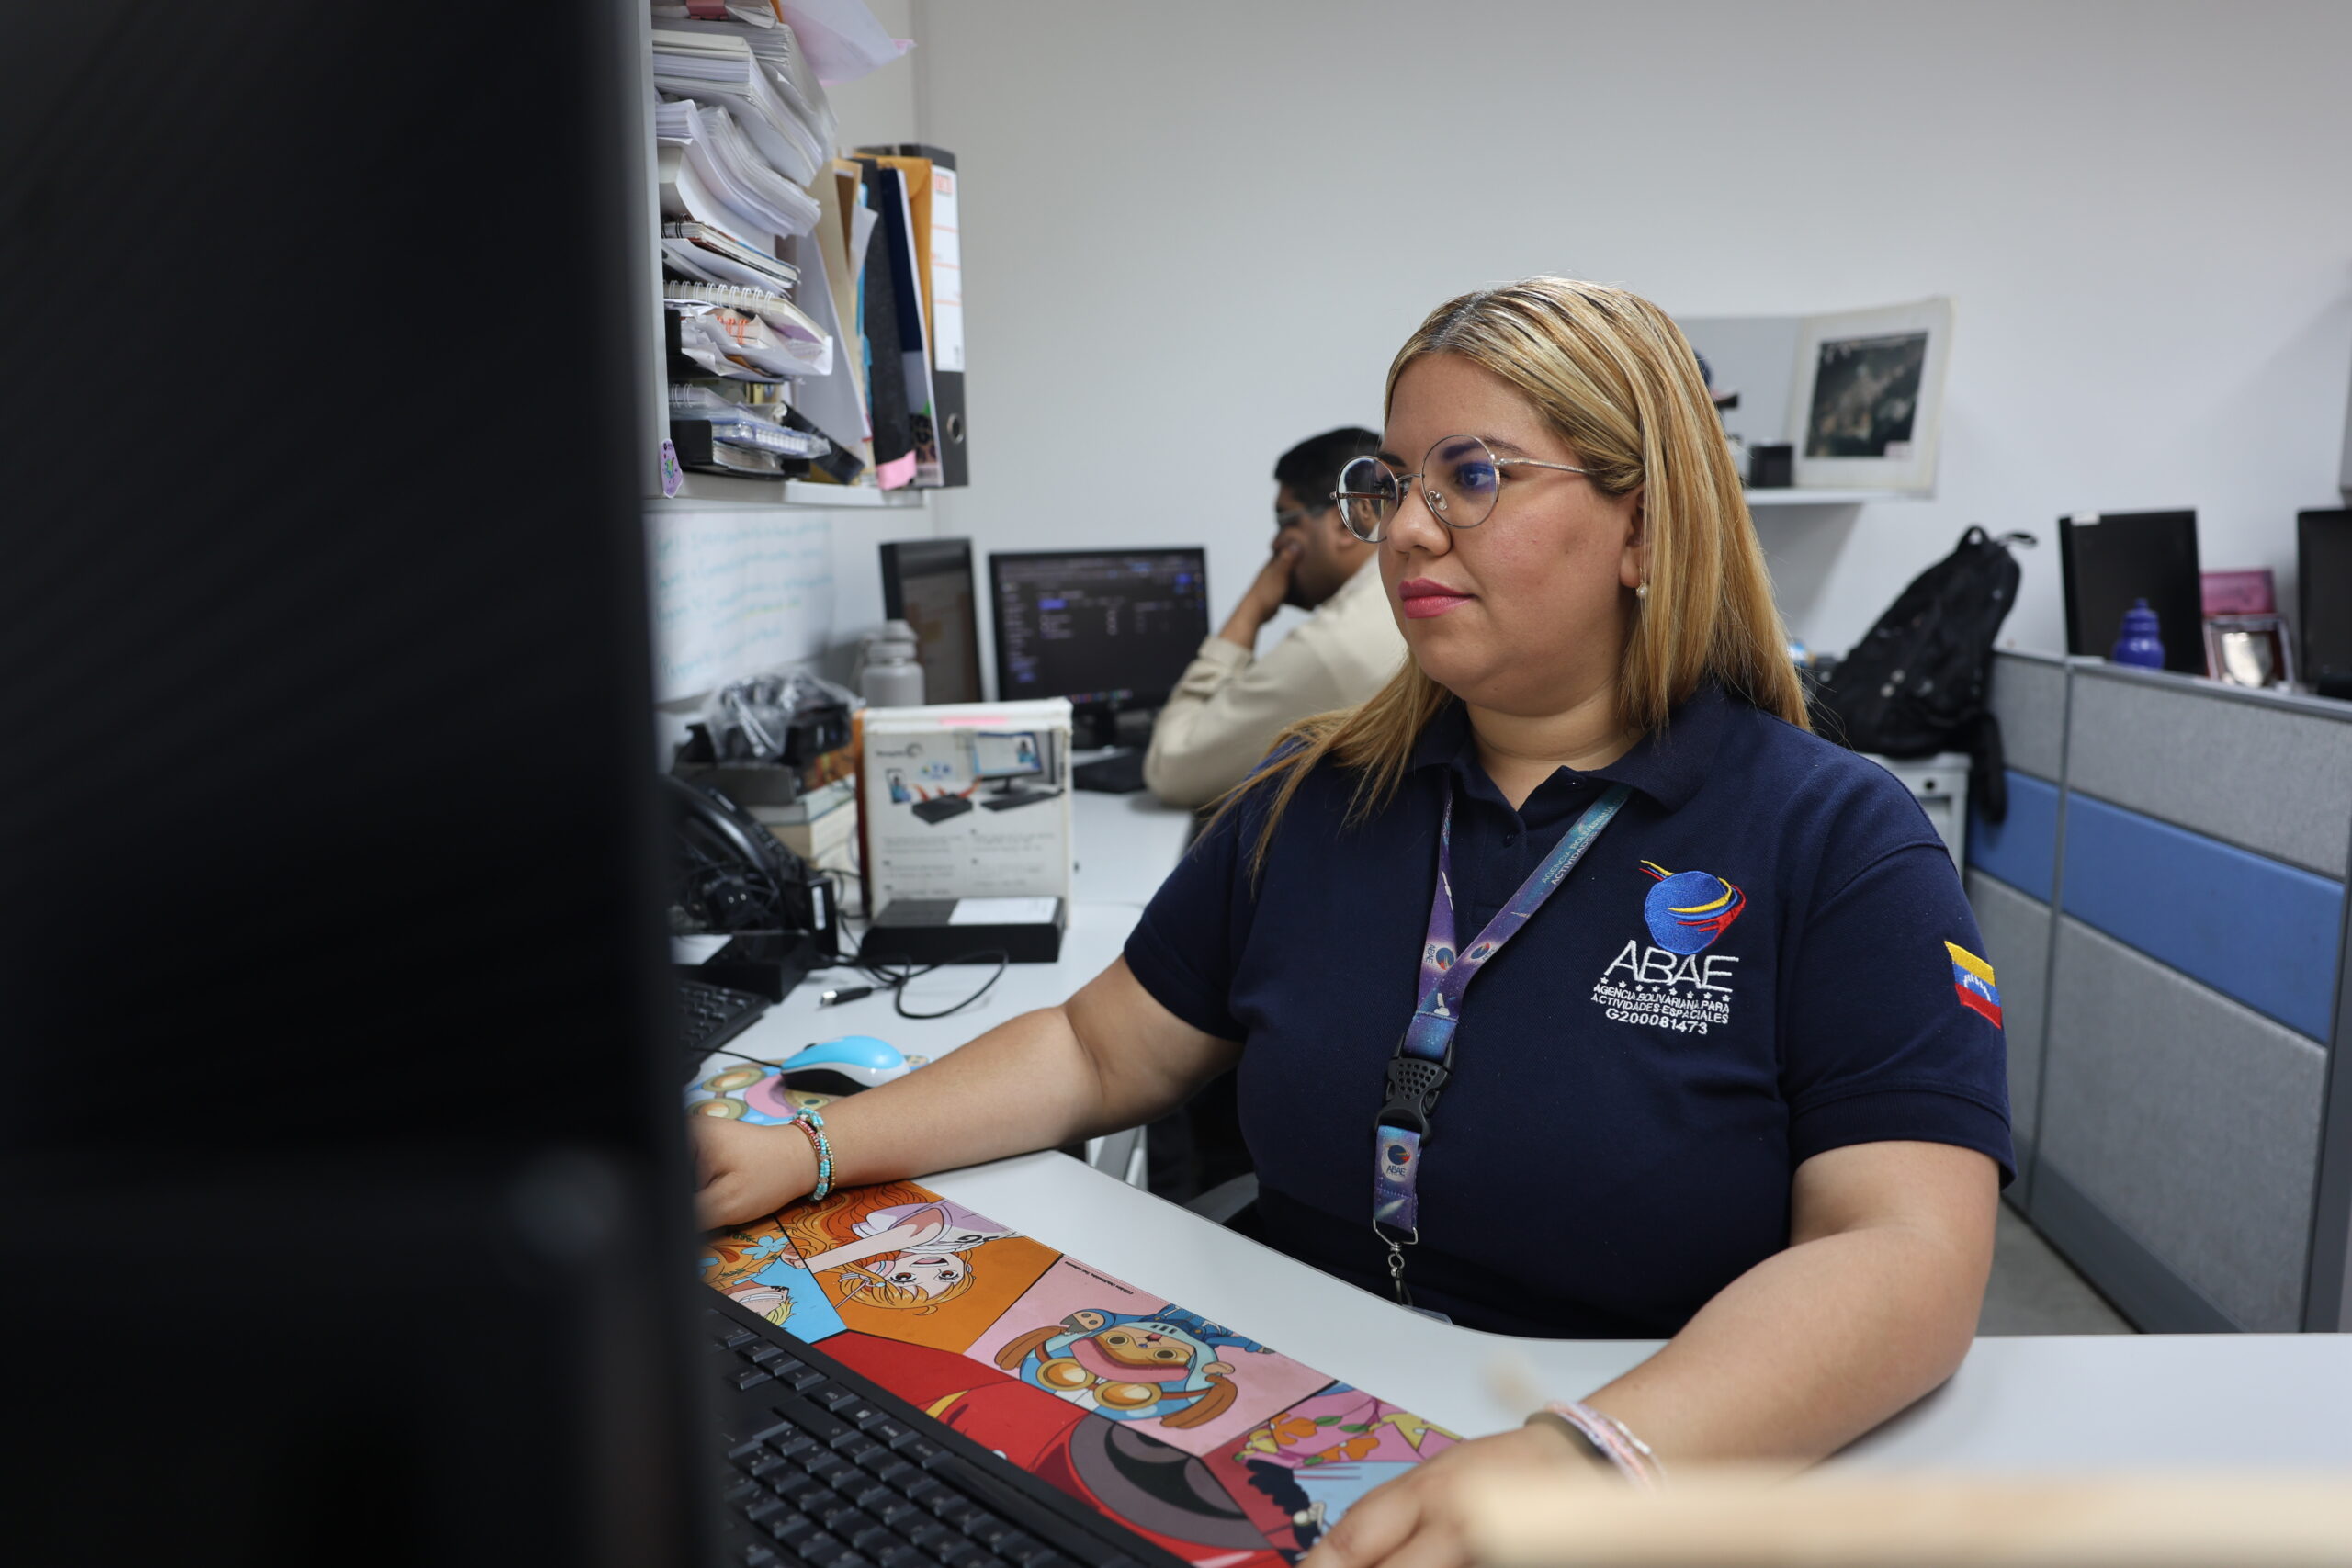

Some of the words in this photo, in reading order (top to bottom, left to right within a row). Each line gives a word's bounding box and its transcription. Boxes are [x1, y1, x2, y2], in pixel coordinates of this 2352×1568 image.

[1542, 851, 1572, 883] AGENCIA
[1604, 940, 1739, 993] ABAE
[1590, 993, 1660, 1012] ACTIVIDADES
[1660, 1004, 1729, 1024] ESPACIALES
[1593, 983, 1635, 1000] AGENCIA
[1636, 992, 1700, 1010] BOLIVARIANA
[1700, 1000, 1729, 1013] PARA
[1605, 1008, 1708, 1035] G200081473
[1387, 1165, 1407, 1176] ABAE
